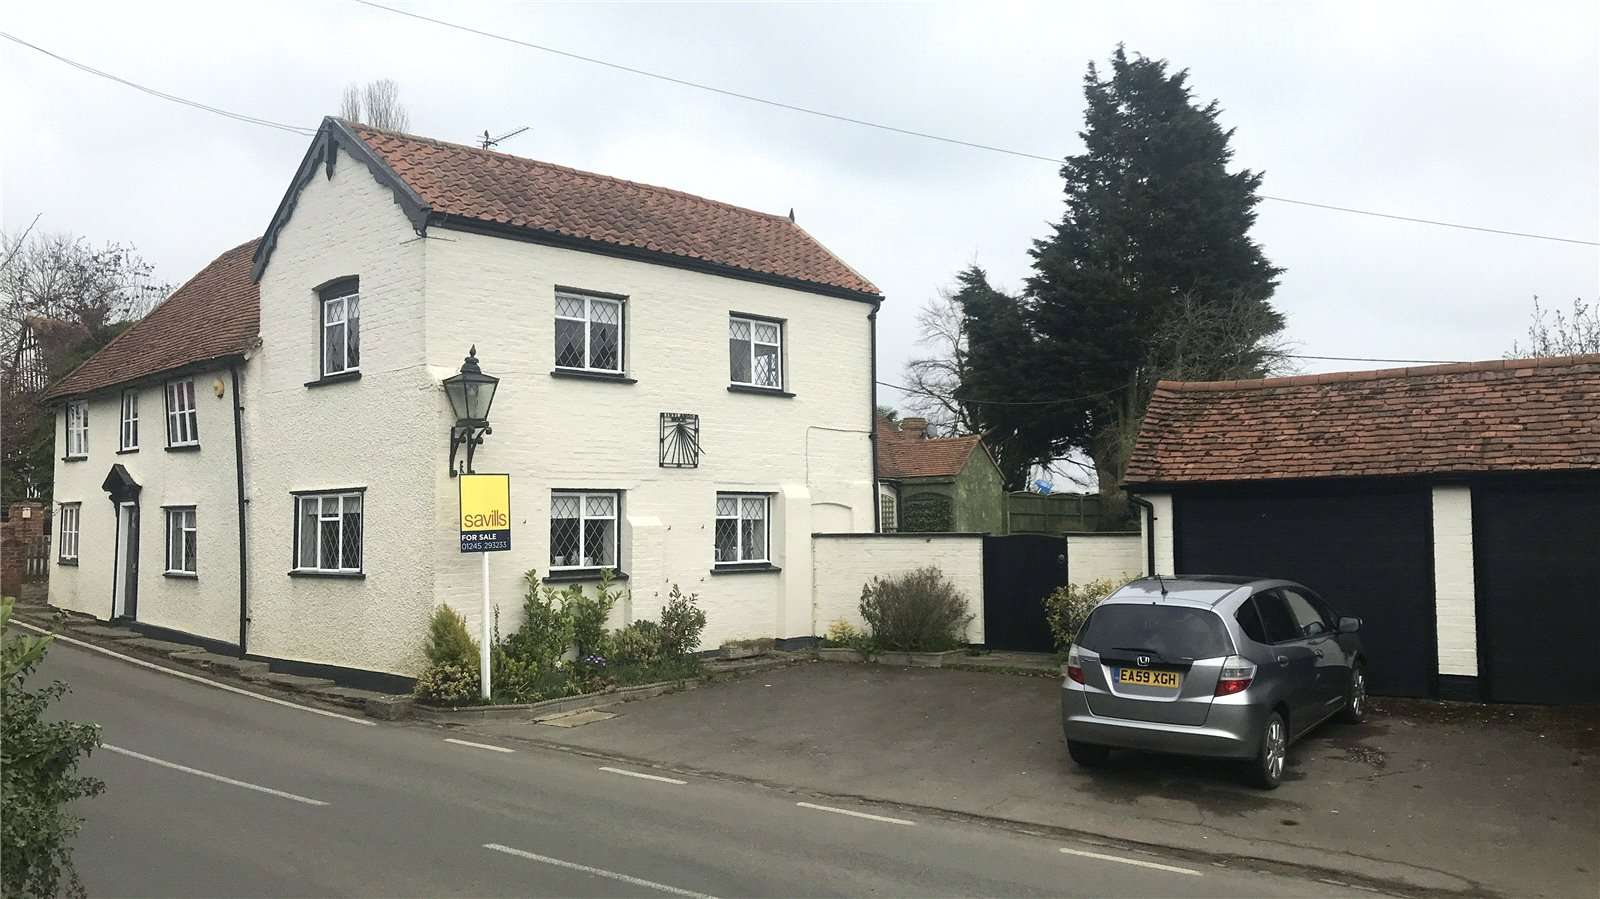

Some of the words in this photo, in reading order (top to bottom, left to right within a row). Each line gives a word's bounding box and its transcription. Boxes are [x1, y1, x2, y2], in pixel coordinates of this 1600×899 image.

[464, 509, 507, 528] savills
[461, 542, 482, 550] 01245
[1120, 669, 1150, 683] EA59
[1153, 672, 1176, 685] XGH
